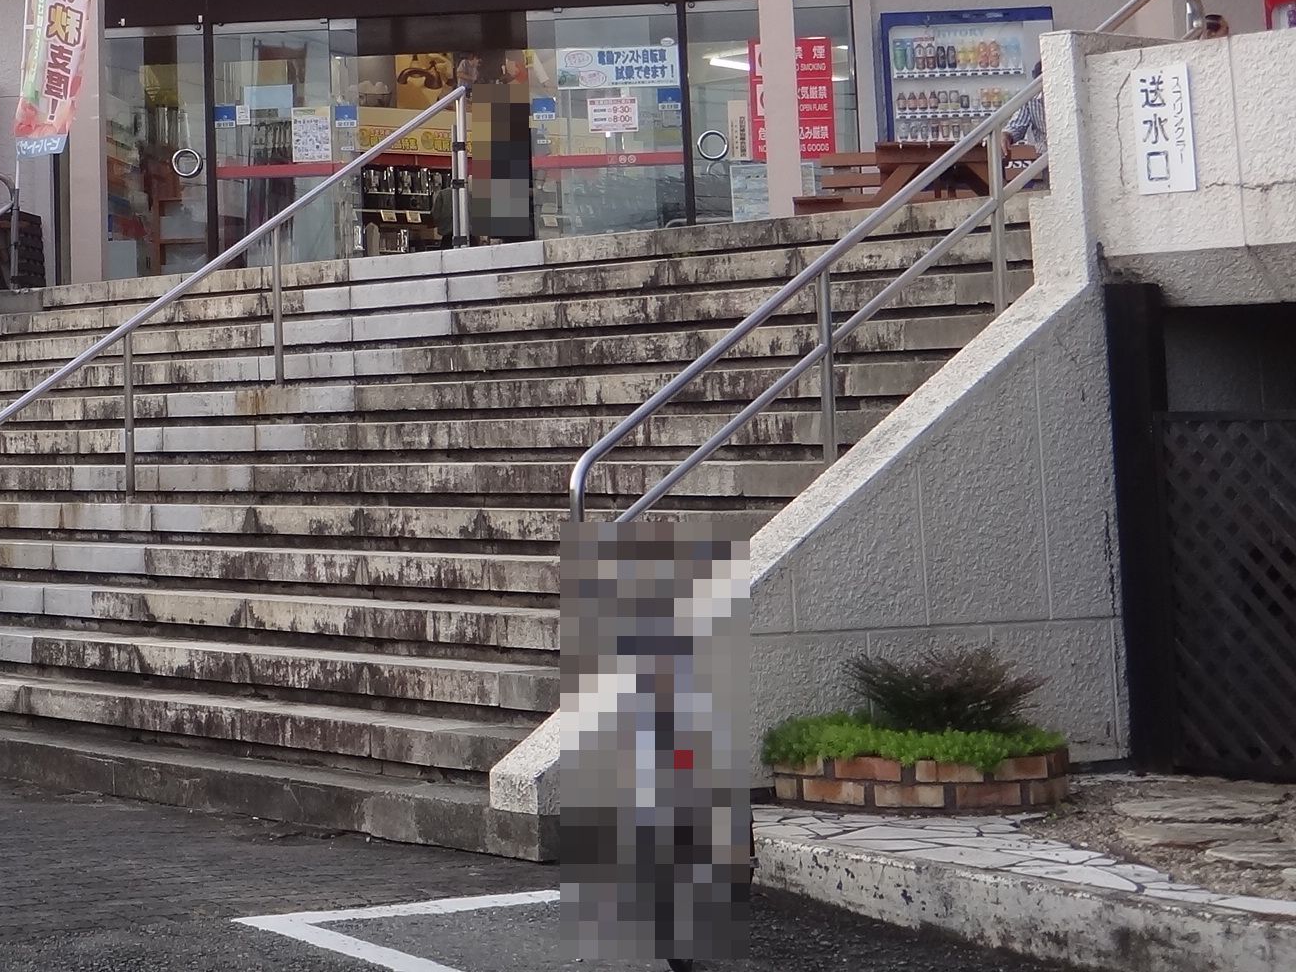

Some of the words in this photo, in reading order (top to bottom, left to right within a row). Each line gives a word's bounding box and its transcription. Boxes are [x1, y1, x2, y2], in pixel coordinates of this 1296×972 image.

[597, 48, 668, 65] 電動アシスト自転車
[800, 63, 826, 71] SMOKING
[1139, 75, 1171, 181] 送水口
[807, 143, 830, 152] GOODS
